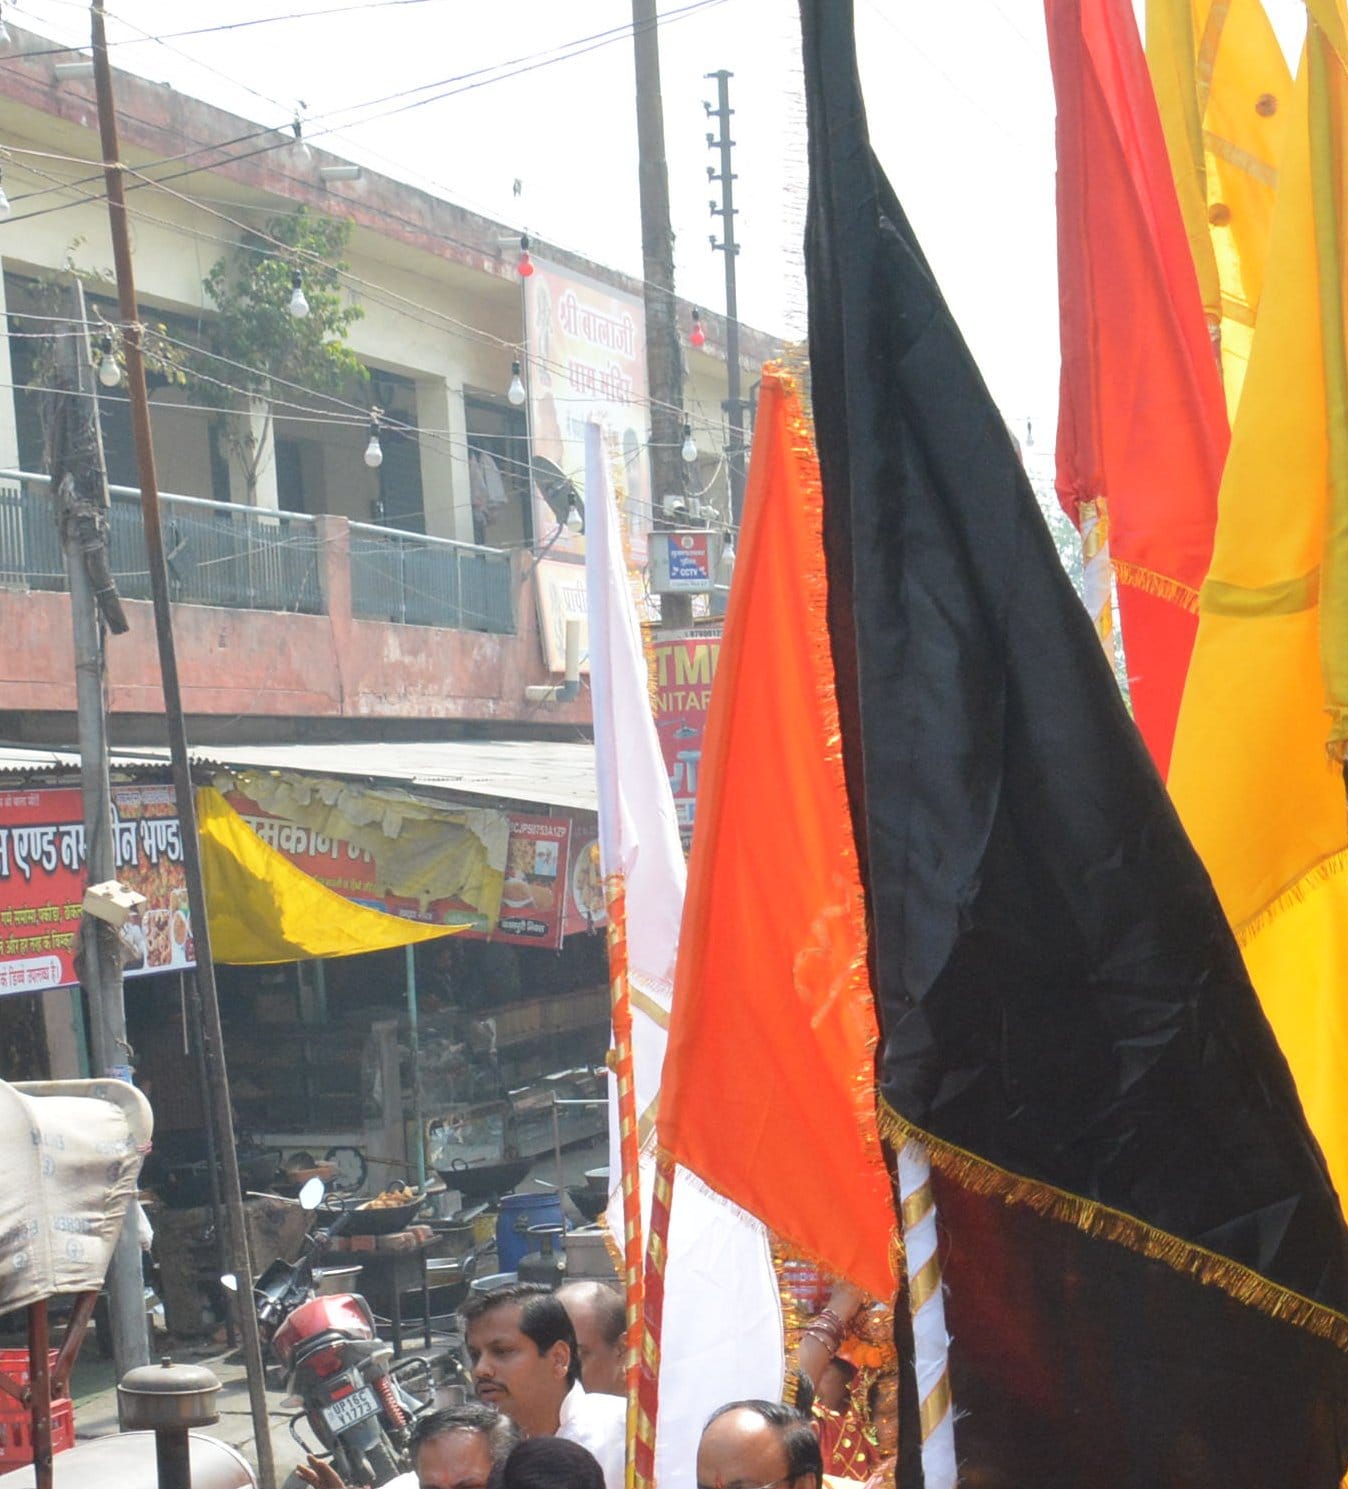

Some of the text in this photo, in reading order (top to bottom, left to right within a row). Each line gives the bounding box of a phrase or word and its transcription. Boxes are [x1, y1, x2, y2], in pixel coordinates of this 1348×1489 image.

[560, 293, 634, 356] श्री बालाजी
[680, 568, 698, 577] CCTV
[12, 827, 57, 879] एण्ड
[60, 802, 138, 870] नीन
[140, 819, 184, 864] भण्डा
[338, 1401, 372, 1425] Y1773
